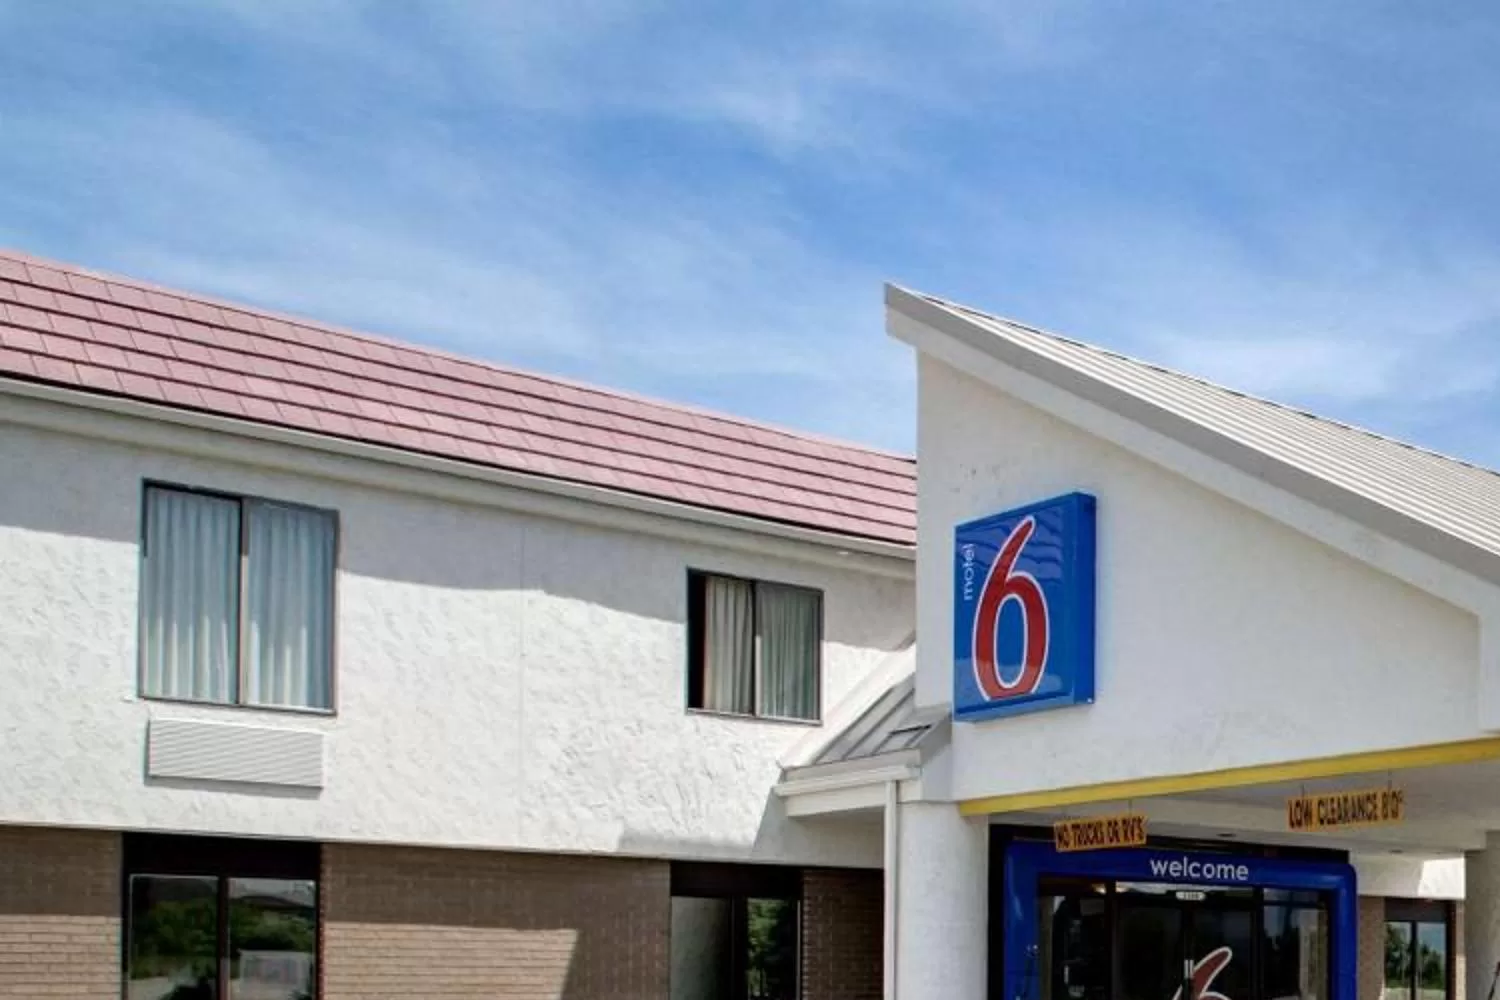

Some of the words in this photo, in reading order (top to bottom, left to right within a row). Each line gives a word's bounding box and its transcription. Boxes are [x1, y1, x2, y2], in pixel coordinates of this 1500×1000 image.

[961, 542, 976, 601] motel
[971, 515, 1049, 701] 6
[1288, 799, 1313, 829] LOW
[1317, 792, 1378, 826] CLEARANCE
[1056, 822, 1070, 849] NO
[1071, 820, 1104, 847] TRUCKS
[1107, 819, 1121, 844] OR
[1150, 856, 1249, 881] welcome
